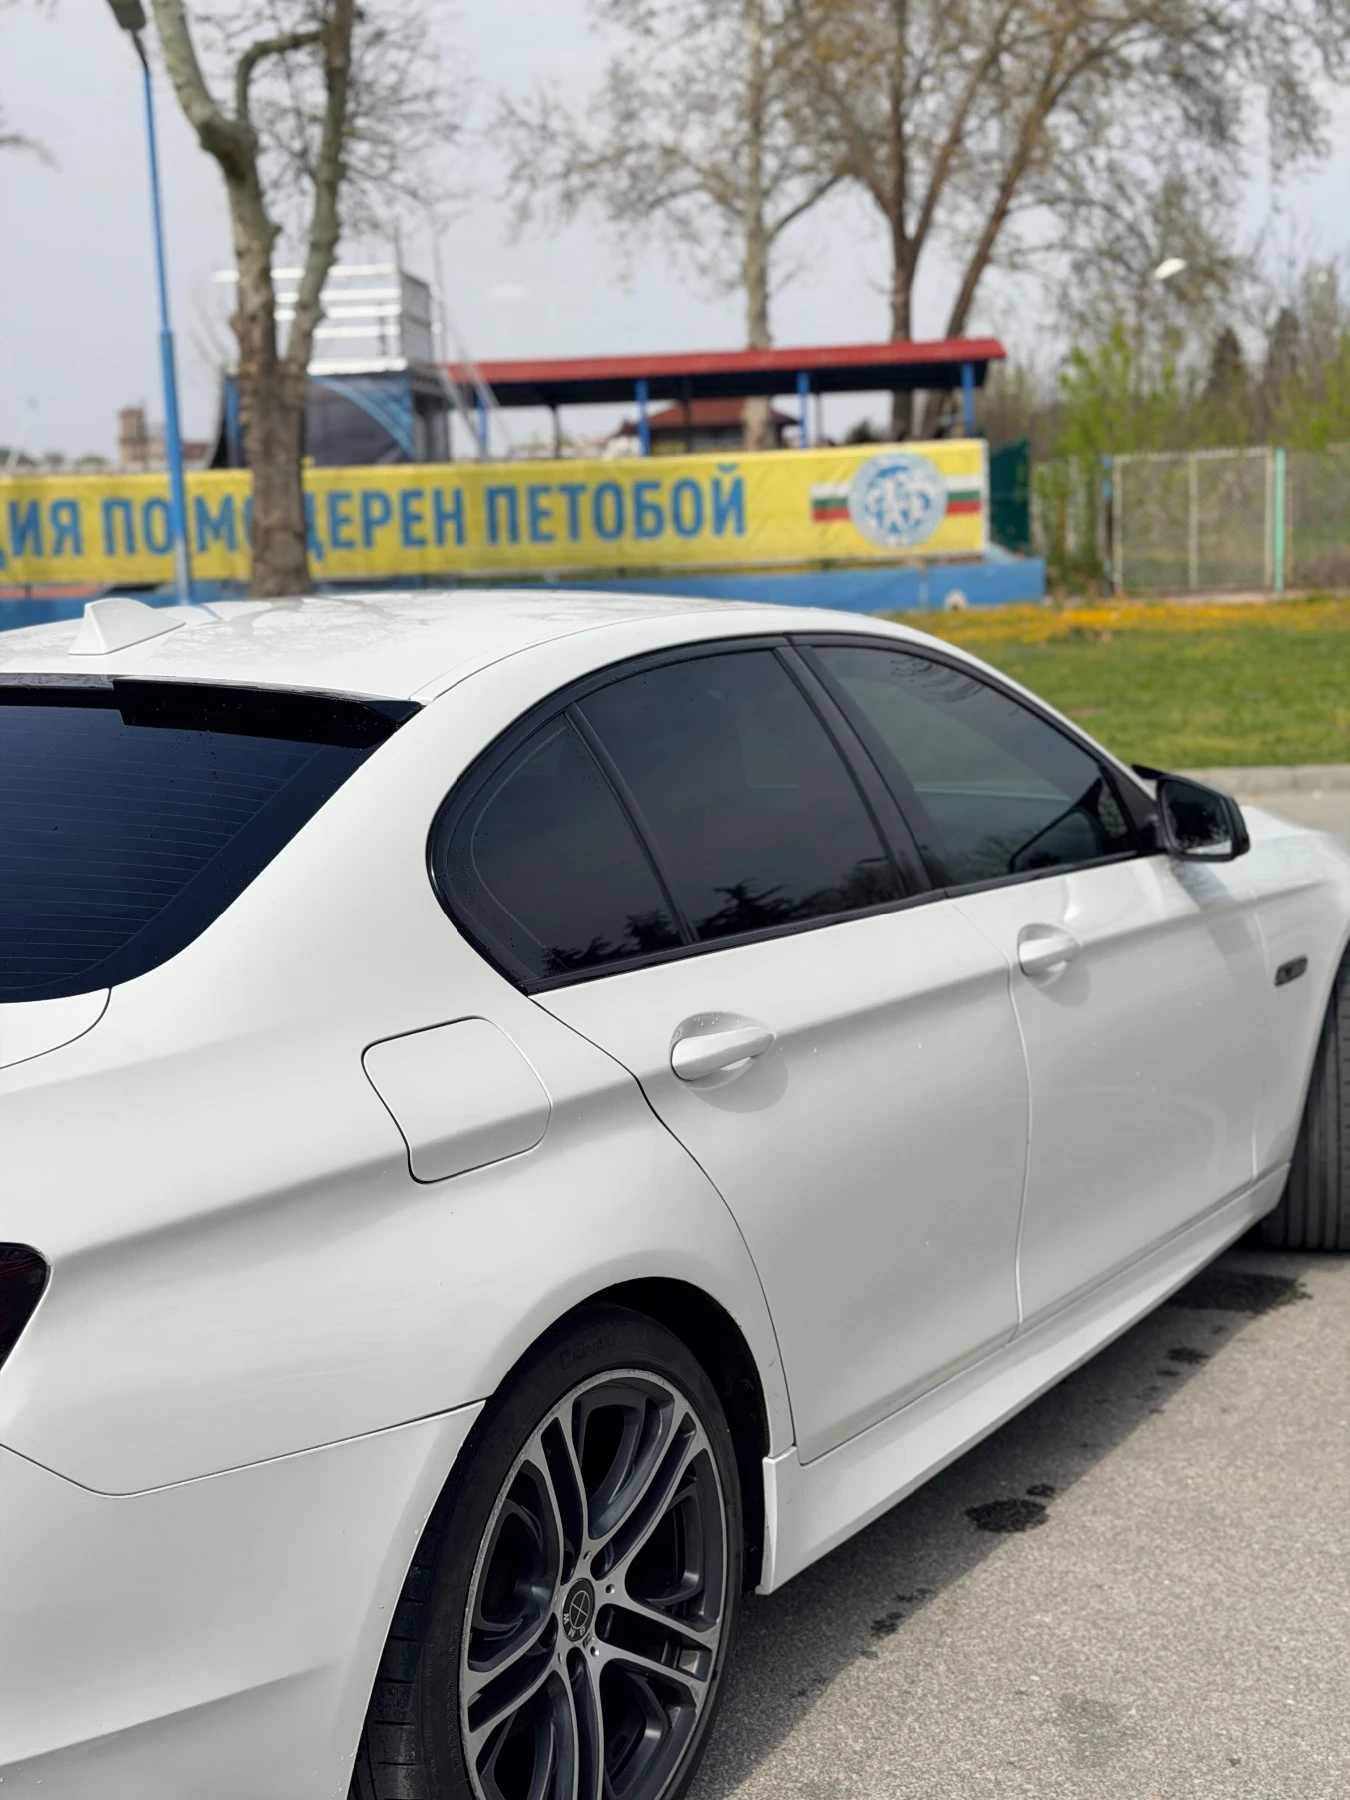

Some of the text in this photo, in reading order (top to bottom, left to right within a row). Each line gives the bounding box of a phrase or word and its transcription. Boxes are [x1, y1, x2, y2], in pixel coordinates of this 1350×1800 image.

[0, 497, 84, 572] ИЯ
[101, 497, 176, 556] ПО
[484, 463, 746, 545] ПЕТОБОЙ
